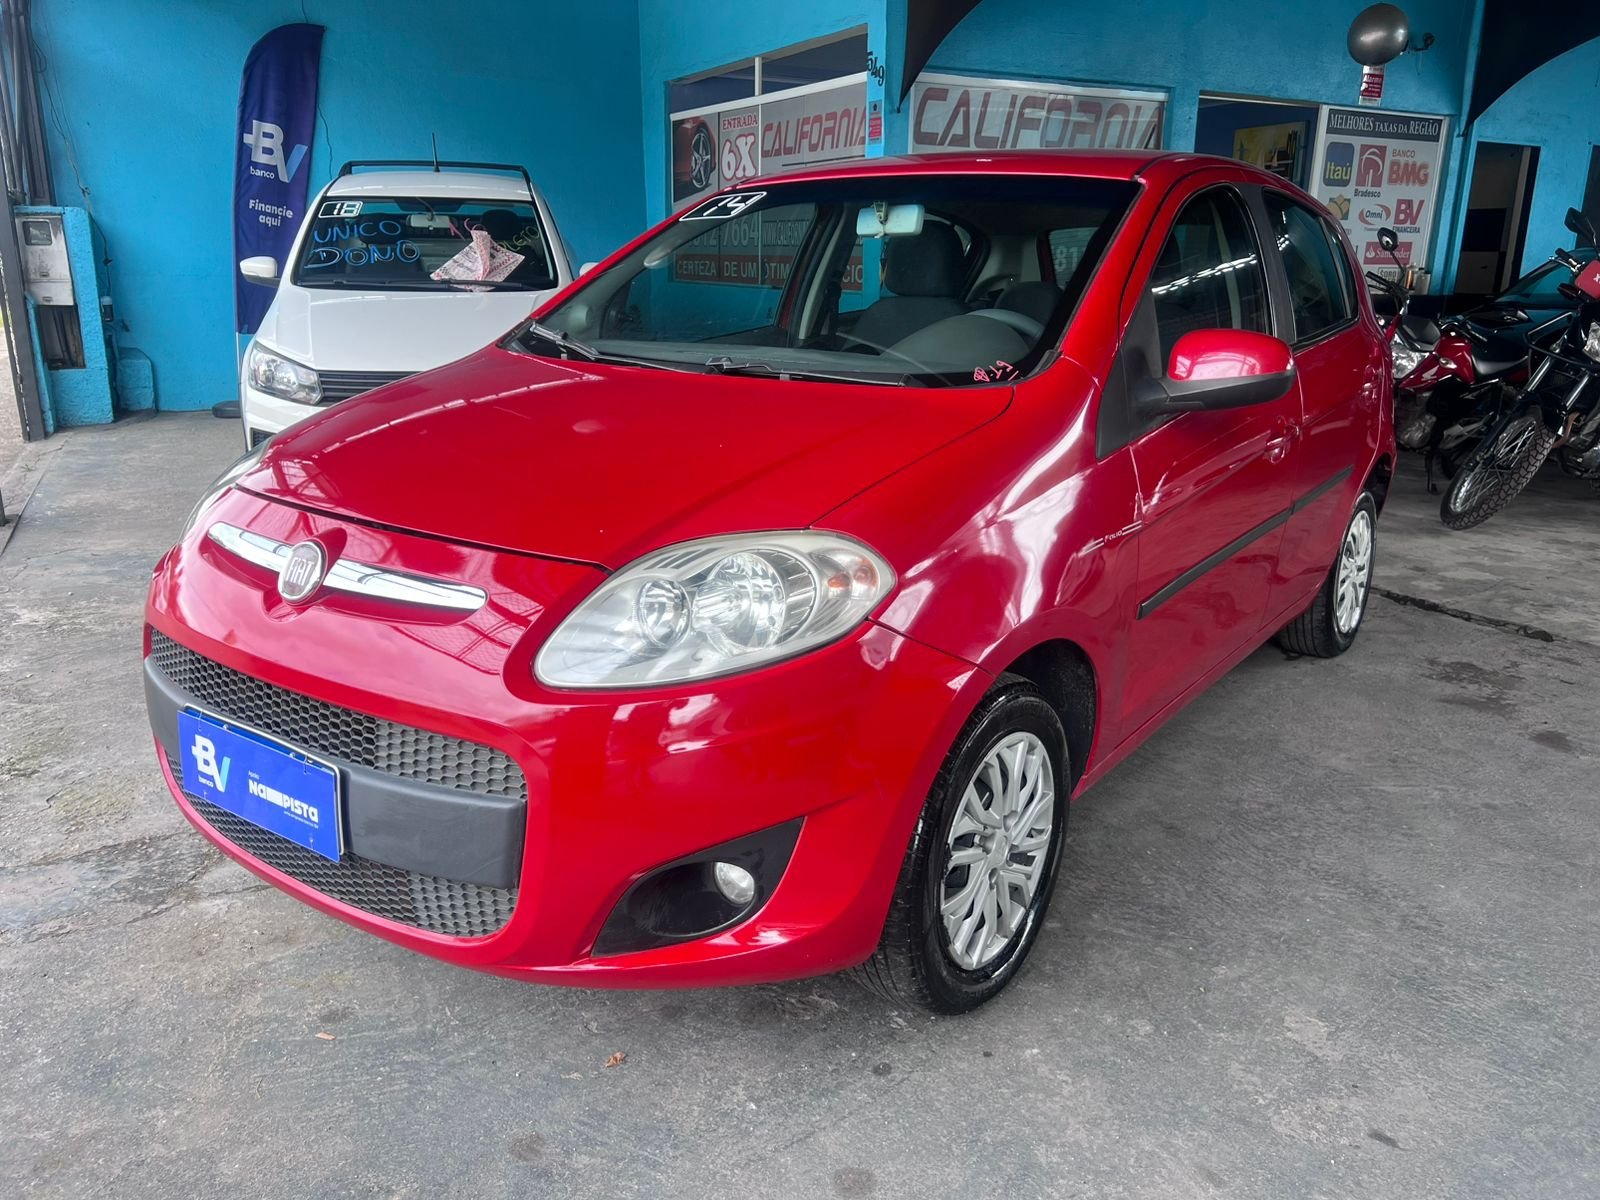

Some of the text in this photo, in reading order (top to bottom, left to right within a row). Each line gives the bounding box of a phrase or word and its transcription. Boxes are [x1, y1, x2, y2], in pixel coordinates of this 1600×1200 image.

[722, 112, 759, 132] ENTRADA
[913, 87, 1163, 149] CALIFORNIA
[1329, 113, 1439, 136] MELHORES TAXAS DA REGIÃO
[761, 105, 867, 157] CALIFORNIA
[243, 119, 309, 183] BV
[720, 132, 758, 182] 6X
[1392, 148, 1415, 158] BANCO
[250, 166, 275, 180] banco
[1325, 161, 1352, 180] Itaú
[1387, 160, 1429, 187] BMG
[1354, 188, 1381, 198] Bradesco
[249, 199, 294, 218] Financie
[332, 201, 361, 216] 18
[1365, 209, 1384, 219] Omni
[1393, 198, 1425, 226] BV
[258, 215, 281, 228] aqui
[314, 220, 402, 243] UNICO
[304, 240, 420, 268] DONO
[677, 260, 717, 277] CERTEZA
[723, 261, 737, 277] DE
[740, 261, 757, 278] UM
[286, 557, 315, 586] FIAT
[191, 734, 232, 793] BV
